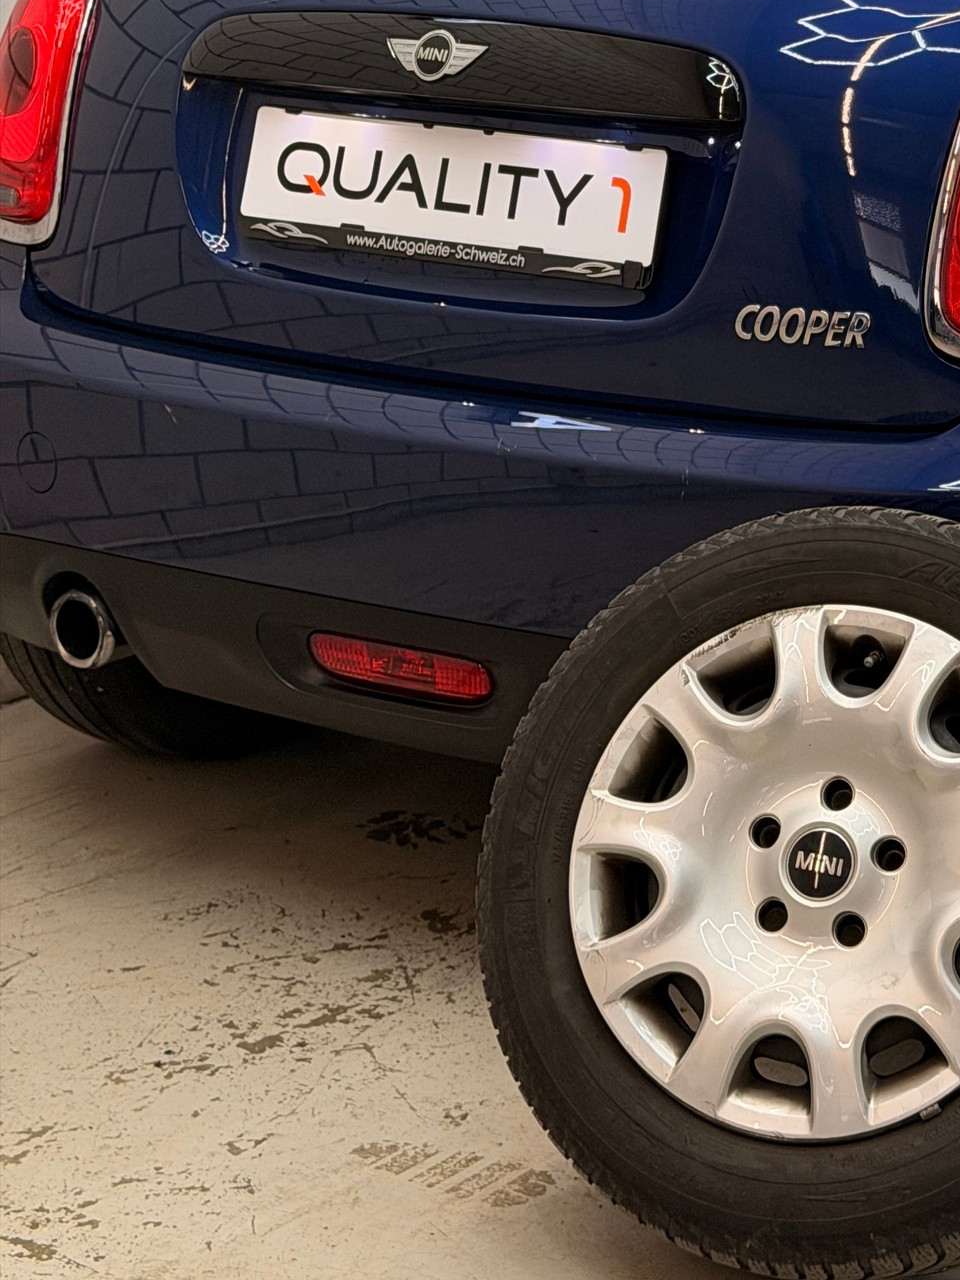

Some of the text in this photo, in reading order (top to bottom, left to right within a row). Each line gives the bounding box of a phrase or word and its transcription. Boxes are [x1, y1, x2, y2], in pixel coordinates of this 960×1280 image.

[417, 46, 449, 63] MINI
[276, 141, 632, 233] QUALITY 1
[346, 233, 525, 268] www.Autogalerie-Schweiz.ch
[734, 304, 871, 349] COOPER
[795, 850, 845, 877] MINI
